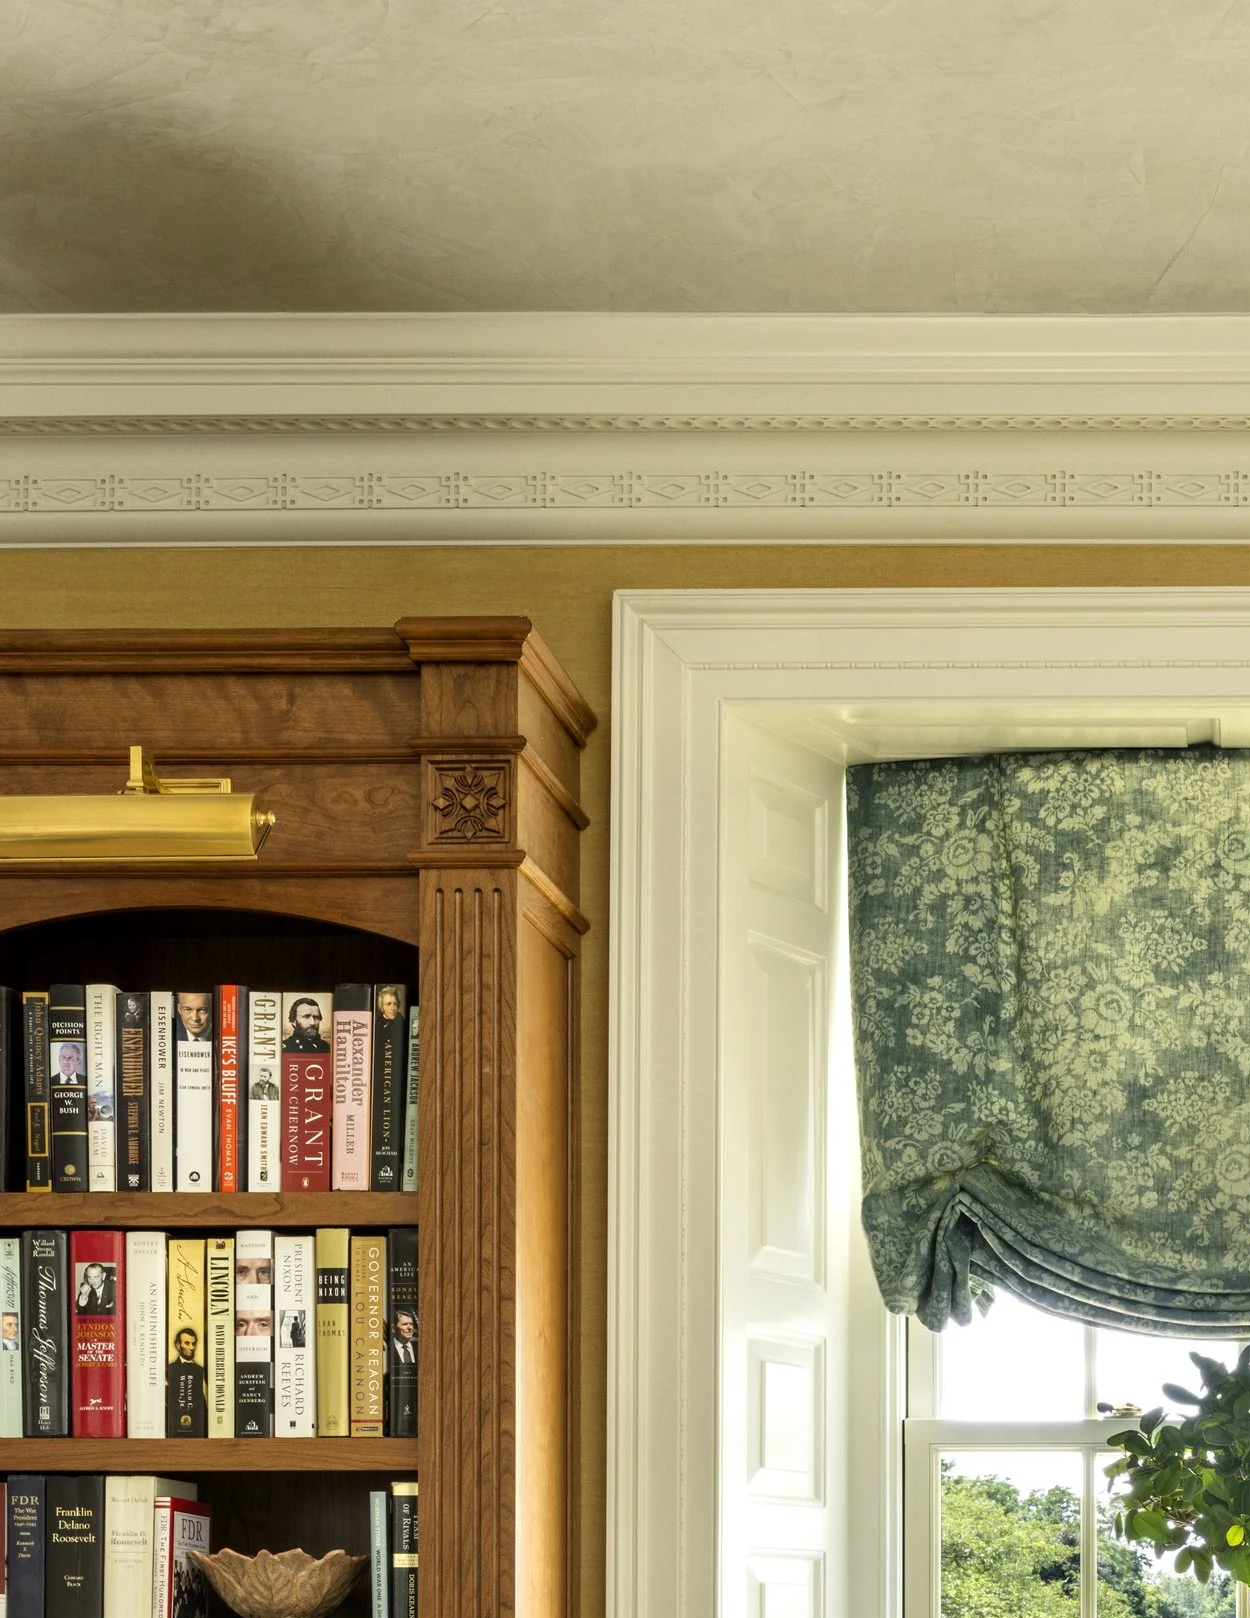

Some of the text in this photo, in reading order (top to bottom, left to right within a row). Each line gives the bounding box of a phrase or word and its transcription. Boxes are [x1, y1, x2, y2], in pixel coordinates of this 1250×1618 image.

[94, 993, 104, 1088] THE RIGHT MAN
[222, 1035, 237, 1066] IKE'S
[122, 1027, 144, 1097] EISENHOWER
[335, 1021, 351, 1105] Hamilton
[351, 1019, 368, 1106] Alexander
[54, 1091, 84, 1099] GEORGE
[221, 1069, 236, 1105] BLUFF
[288, 1064, 299, 1166] RON CHERNOW
[304, 1064, 324, 1166] GRANT
[346, 1114, 355, 1155] MILLER
[283, 1255, 292, 1293] NIXON
[294, 1243, 303, 1303] PRESIDENT
[318, 1275, 345, 1285] BEING
[318, 1287, 346, 1297] NIXON
[76, 1342, 115, 1351] MASTER
[210, 1256, 229, 1413] LINCOLN DAVID HERBERT DONALD
[368, 1247, 379, 1415] GOVERNOR REAGAN
[78, 1354, 114, 1362] SENATE
[355, 1292, 365, 1415] LOU CANNON
[281, 1362, 292, 1408] REEVES
[294, 1354, 304, 1416] RICHARD
[10, 1495, 40, 1505] FDR
[55, 1507, 93, 1517] Franklin
[52, 1533, 96, 1543] Roosevelt
[58, 1520, 90, 1530] Delano
[181, 1518, 203, 1542] FDR
